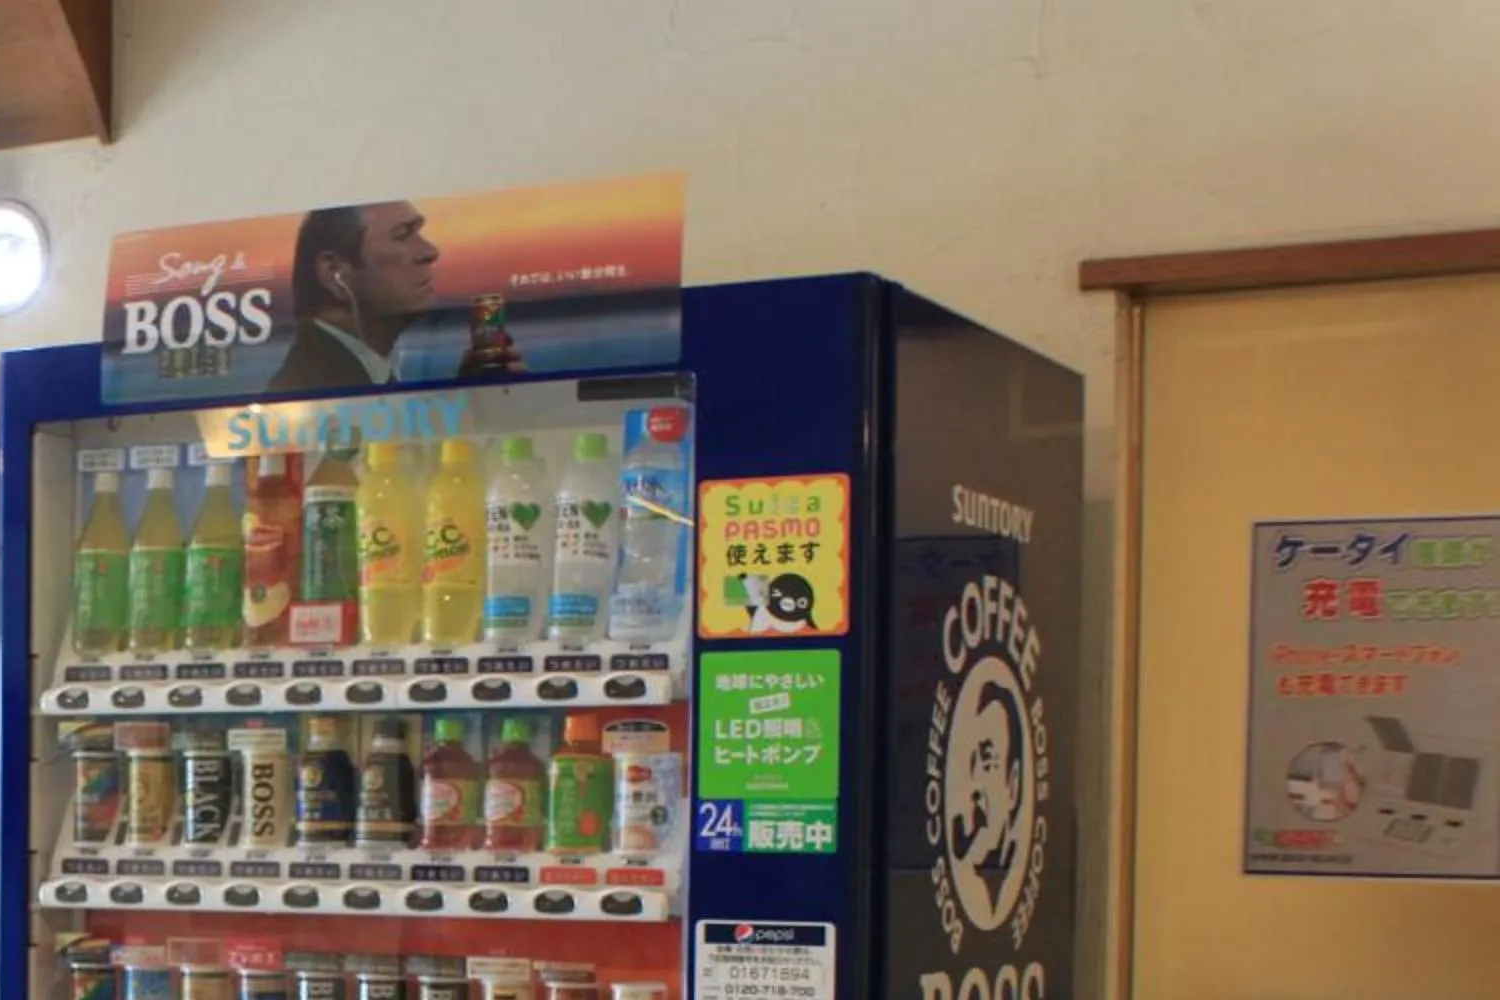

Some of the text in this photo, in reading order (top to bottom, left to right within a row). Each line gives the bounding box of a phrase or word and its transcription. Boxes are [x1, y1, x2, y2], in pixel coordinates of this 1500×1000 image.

[121, 287, 273, 356] BOSS
[723, 518, 822, 541] PASMO
[726, 541, 821, 568] 使えます
[942, 574, 1041, 694] COFFEE
[714, 673, 825, 692] 地球にやさしい
[714, 744, 822, 767] ヒートポンプ
[923, 679, 952, 845] COFFEE
[193, 754, 222, 840] BLACK
[252, 763, 275, 838] BOSS
[747, 819, 833, 851] 販売中
[754, 927, 795, 942] pepsi
